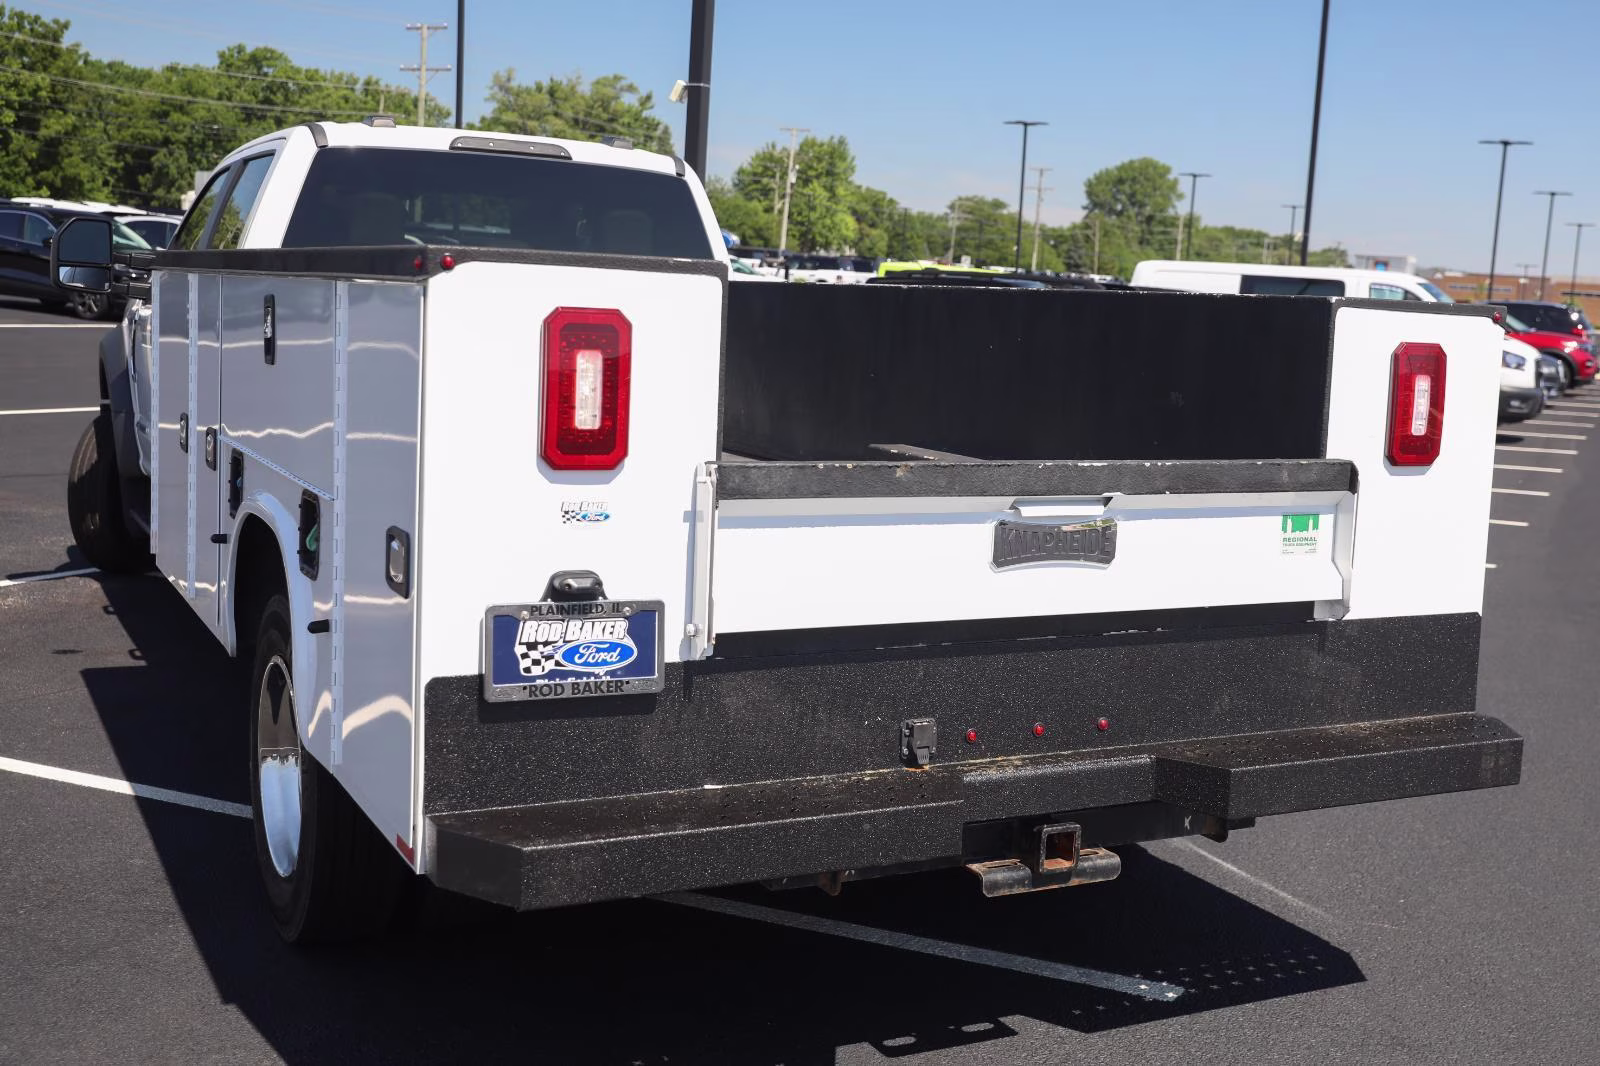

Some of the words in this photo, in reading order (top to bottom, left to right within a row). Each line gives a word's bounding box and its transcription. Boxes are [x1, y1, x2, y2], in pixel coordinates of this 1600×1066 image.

[998, 525, 1114, 562] KNAPHEIDE
[530, 602, 608, 616] PLAINFIELD,
[612, 602, 623, 614] IL
[519, 620, 563, 643] ROD
[564, 618, 627, 641] BAKER
[574, 642, 622, 664] Ford
[528, 683, 564, 698] ROD
[571, 680, 625, 695] BAKER
